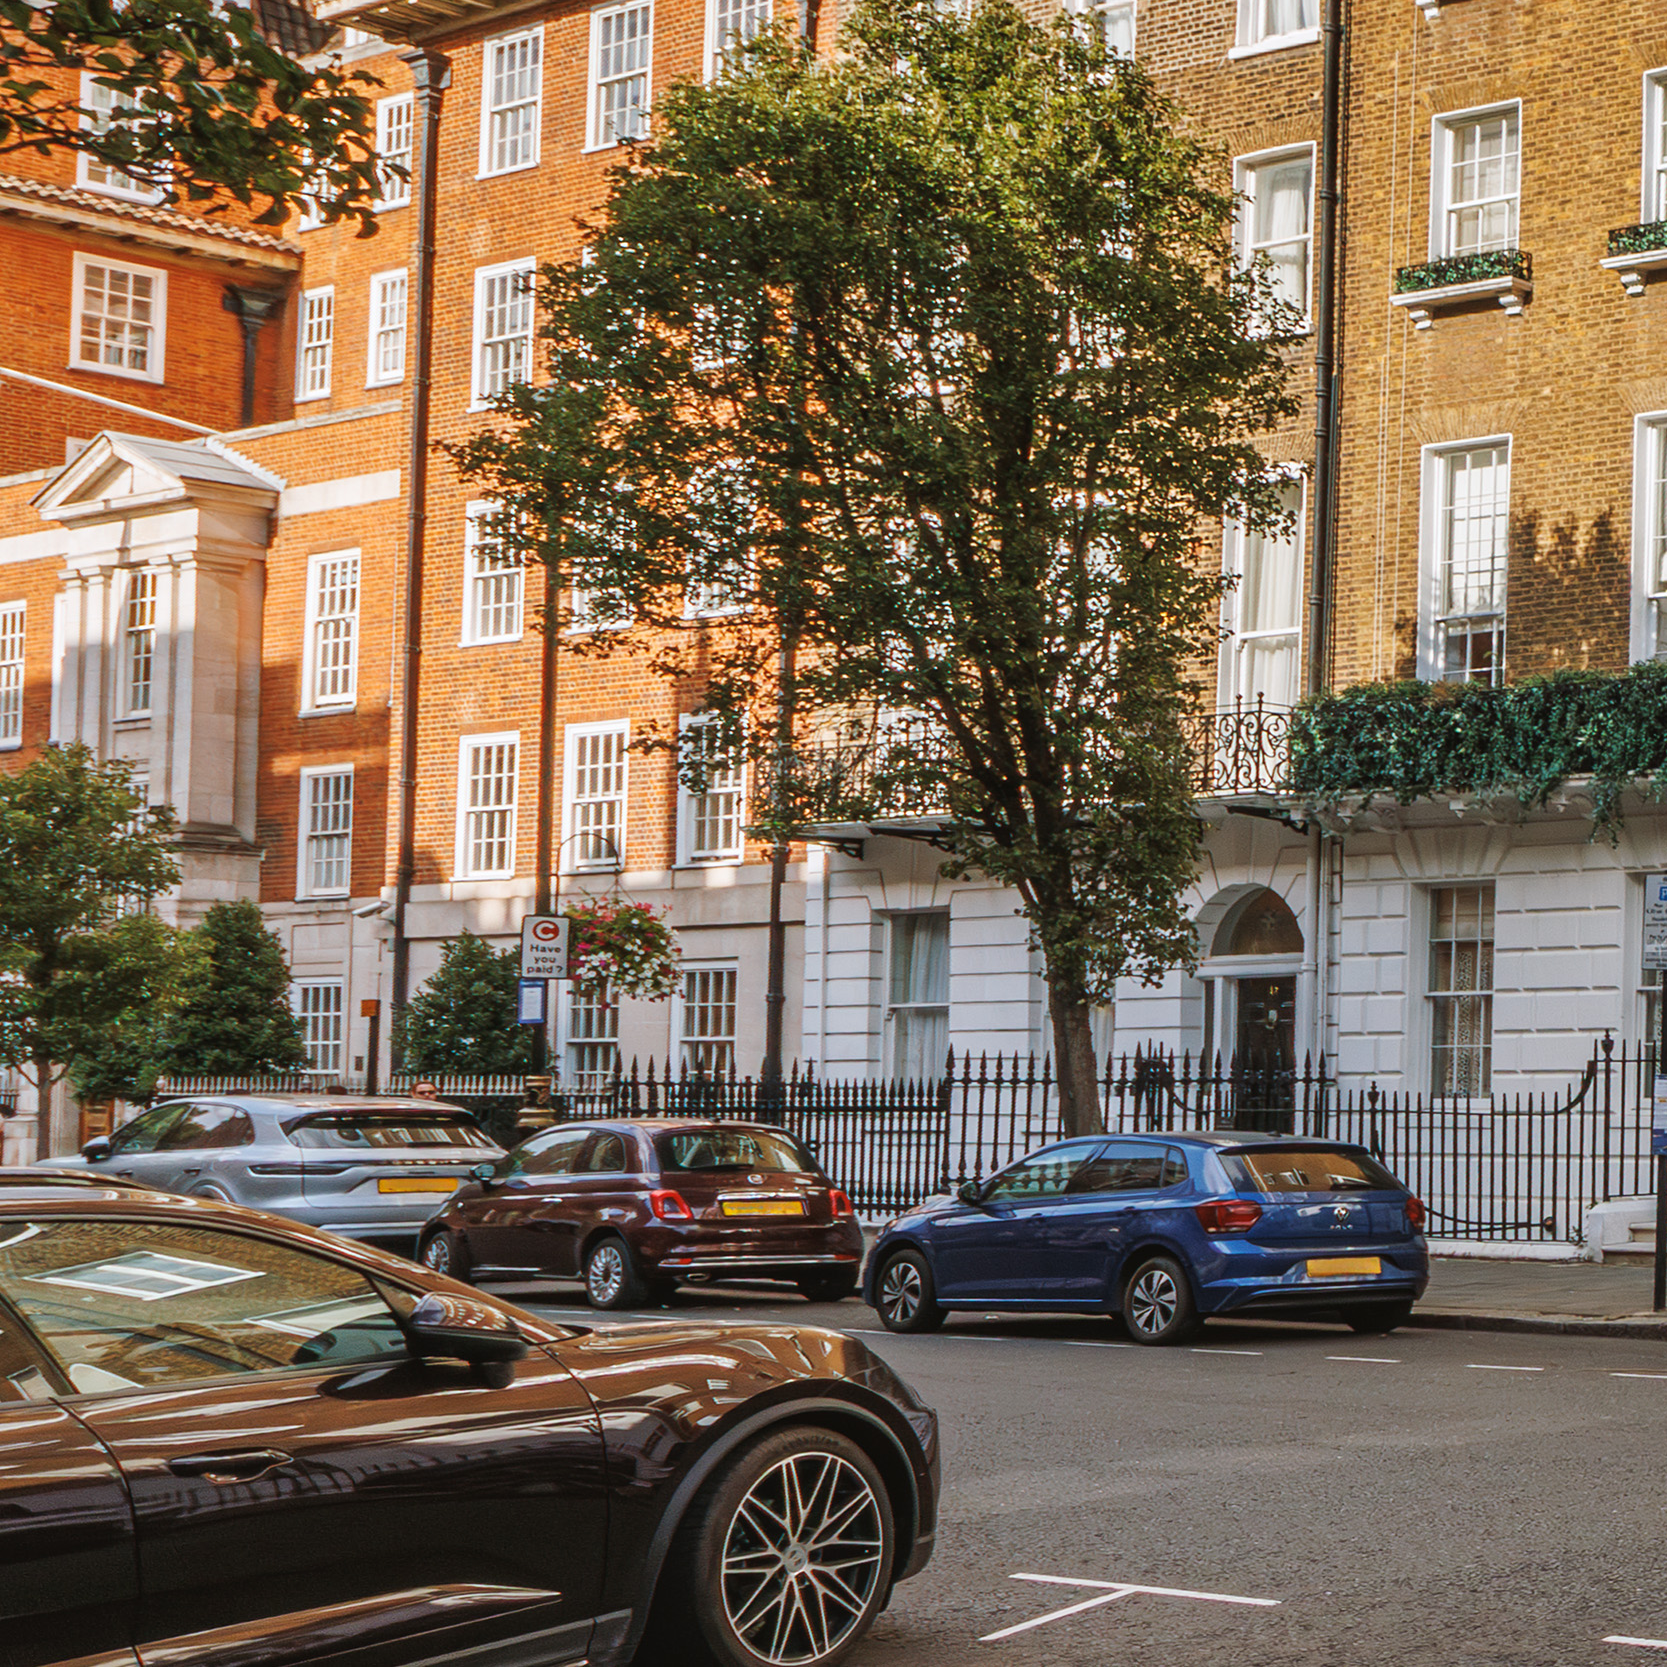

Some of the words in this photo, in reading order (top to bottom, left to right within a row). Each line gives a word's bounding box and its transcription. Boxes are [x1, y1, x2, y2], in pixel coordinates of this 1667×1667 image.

[529, 944, 562, 953] Have
[533, 956, 556, 964] you
[526, 965, 563, 974] paid?
